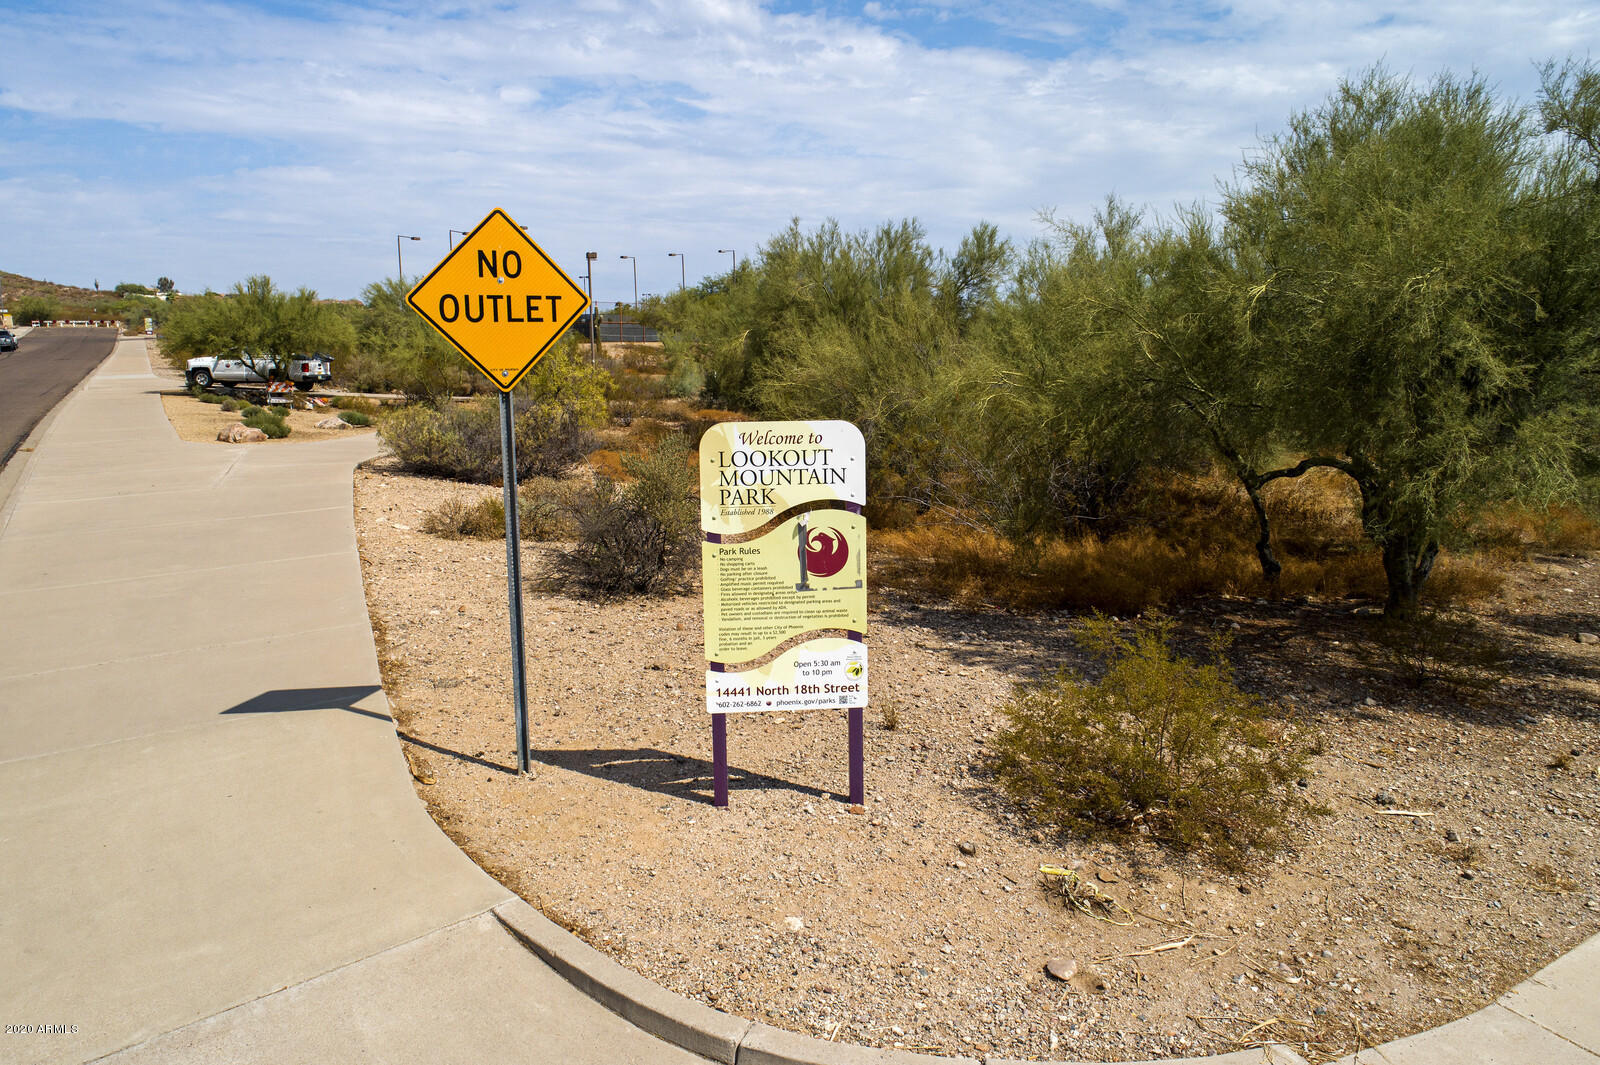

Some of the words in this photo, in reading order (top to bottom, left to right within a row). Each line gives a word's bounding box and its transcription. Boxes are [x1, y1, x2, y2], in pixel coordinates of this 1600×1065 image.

[477, 250, 522, 279] NO
[439, 294, 562, 323] OUTLET
[738, 430, 804, 445] Welcome
[808, 433, 823, 444] to
[718, 449, 834, 468] LOOKOUT
[719, 468, 847, 487] MOUNTAIN
[719, 488, 777, 506] PARK
[720, 508, 756, 516] Established
[719, 547, 737, 555] Park
[739, 547, 761, 555] Rules
[794, 660, 812, 668] Open
[716, 686, 751, 697] 14441
[756, 685, 789, 696] North
[795, 684, 820, 694] 18th
[824, 684, 860, 694] Street
[776, 698, 836, 707] phoenix.gov/parks
